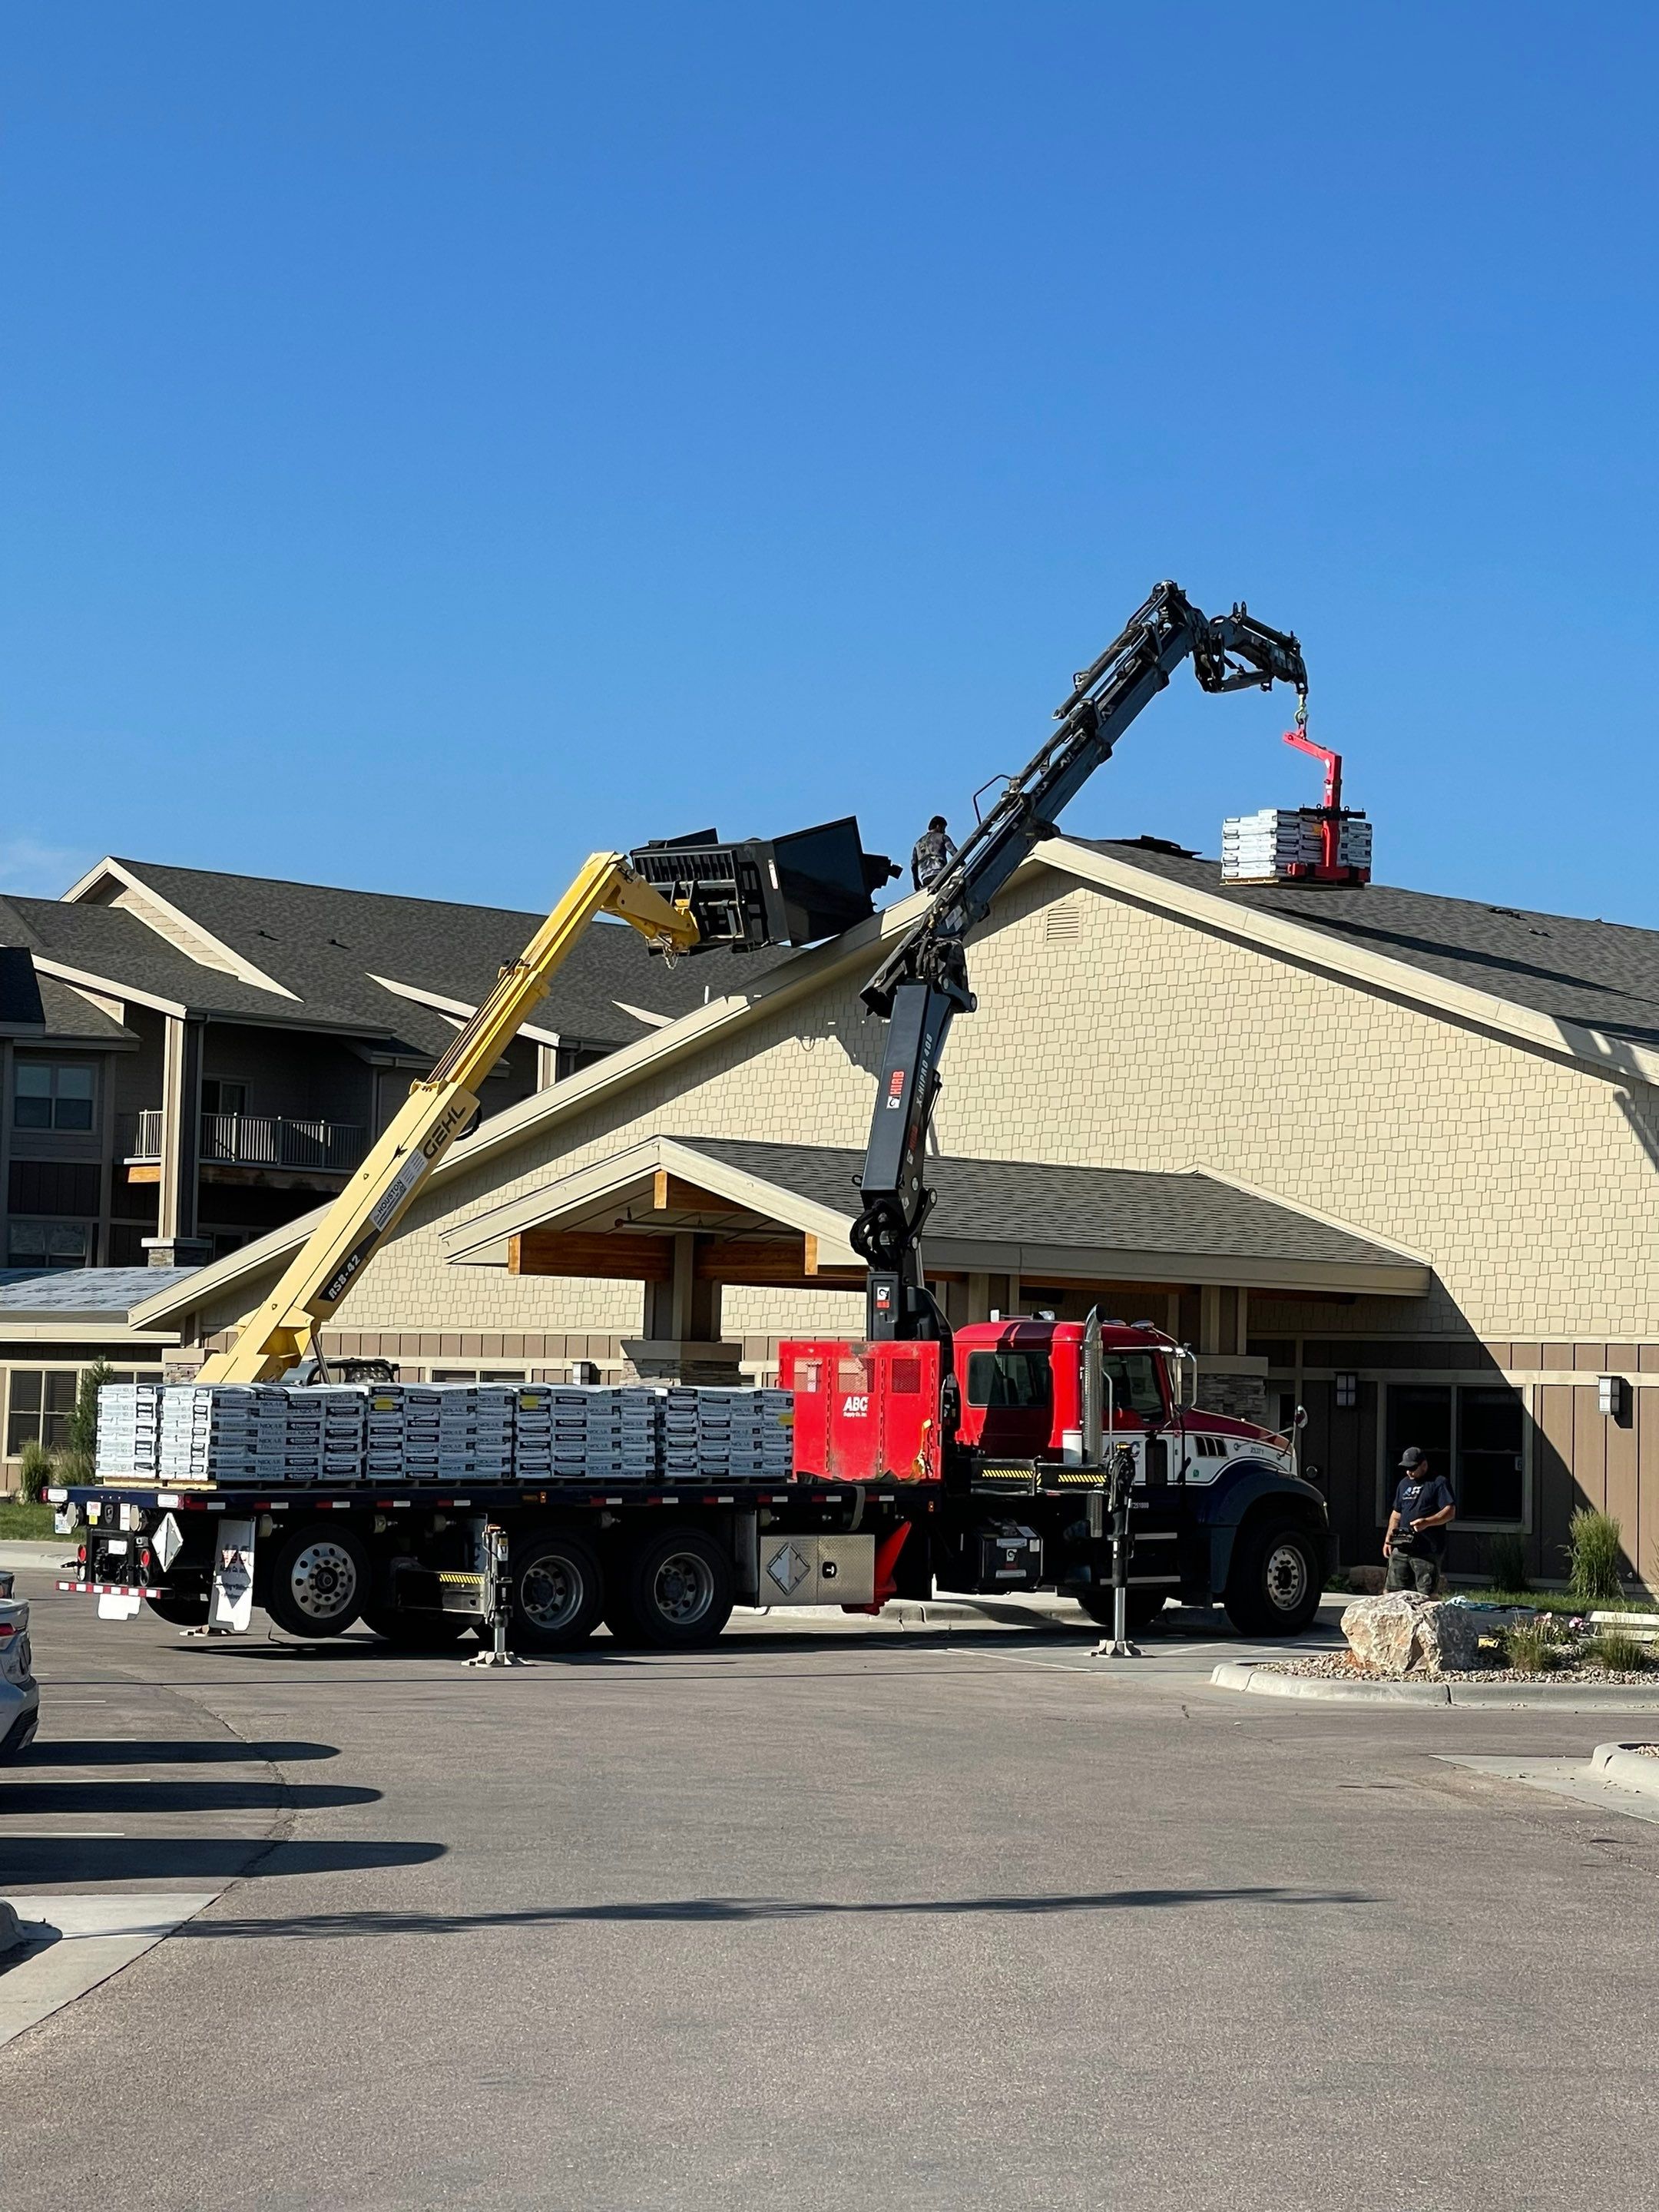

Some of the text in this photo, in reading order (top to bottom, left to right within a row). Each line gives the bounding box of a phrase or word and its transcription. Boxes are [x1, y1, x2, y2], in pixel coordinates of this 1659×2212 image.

[889, 1070, 905, 1095] HIAB
[916, 1062, 929, 1108] X-HIPRO
[423, 1107, 466, 1159] GEHL
[377, 1179, 405, 1214] HOUSTON
[328, 1254, 361, 1300] RS8-42
[843, 1396, 869, 1412] ABC
[1103, 1441, 1142, 1459] AC
